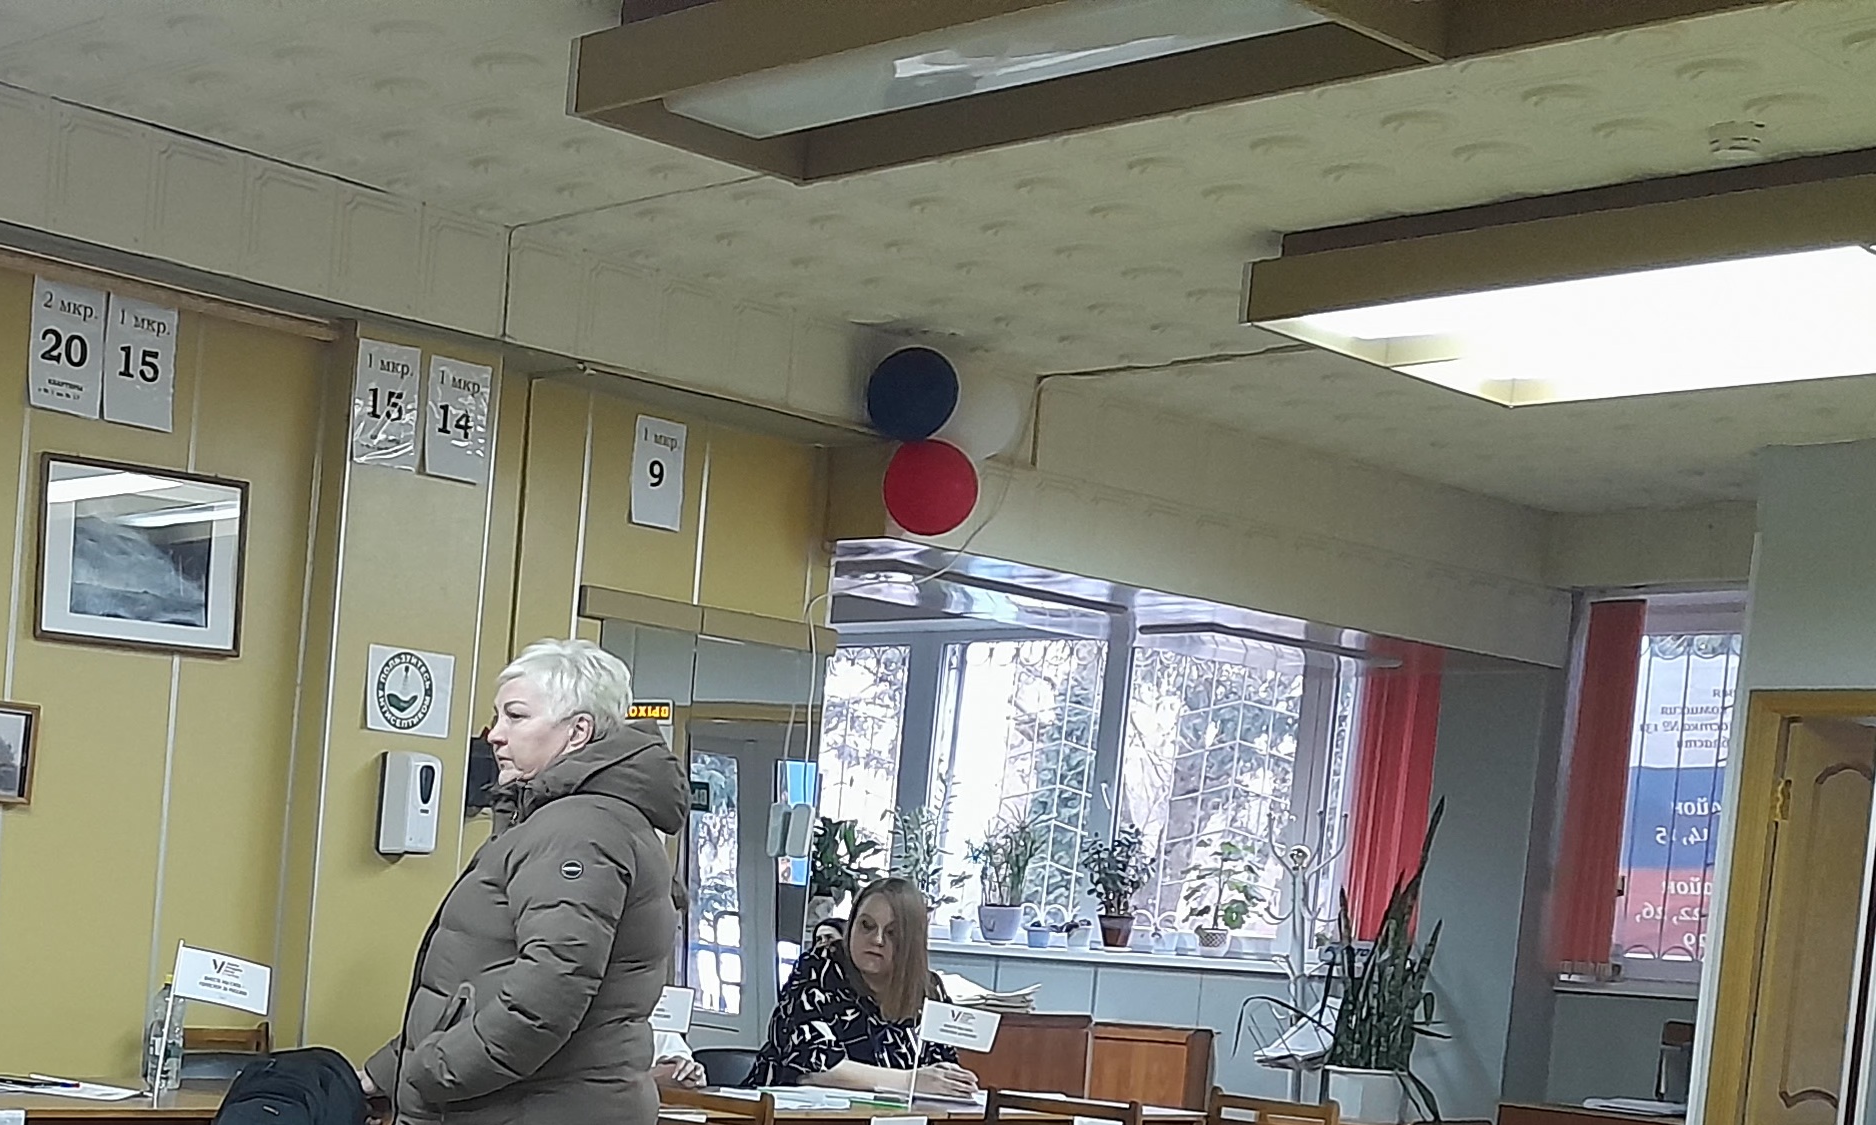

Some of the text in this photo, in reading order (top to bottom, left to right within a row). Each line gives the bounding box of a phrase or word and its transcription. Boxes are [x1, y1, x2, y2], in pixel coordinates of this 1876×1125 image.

[43, 291, 98, 321] 2 мкр.
[120, 308, 171, 338] 1 мкр.
[40, 328, 88, 368] 20
[118, 345, 160, 383] 15
[367, 353, 414, 379] 1 мкр.
[439, 370, 445, 385] 1
[367, 387, 404, 422] 15
[437, 404, 473, 439] 14
[649, 460, 664, 487] 9
